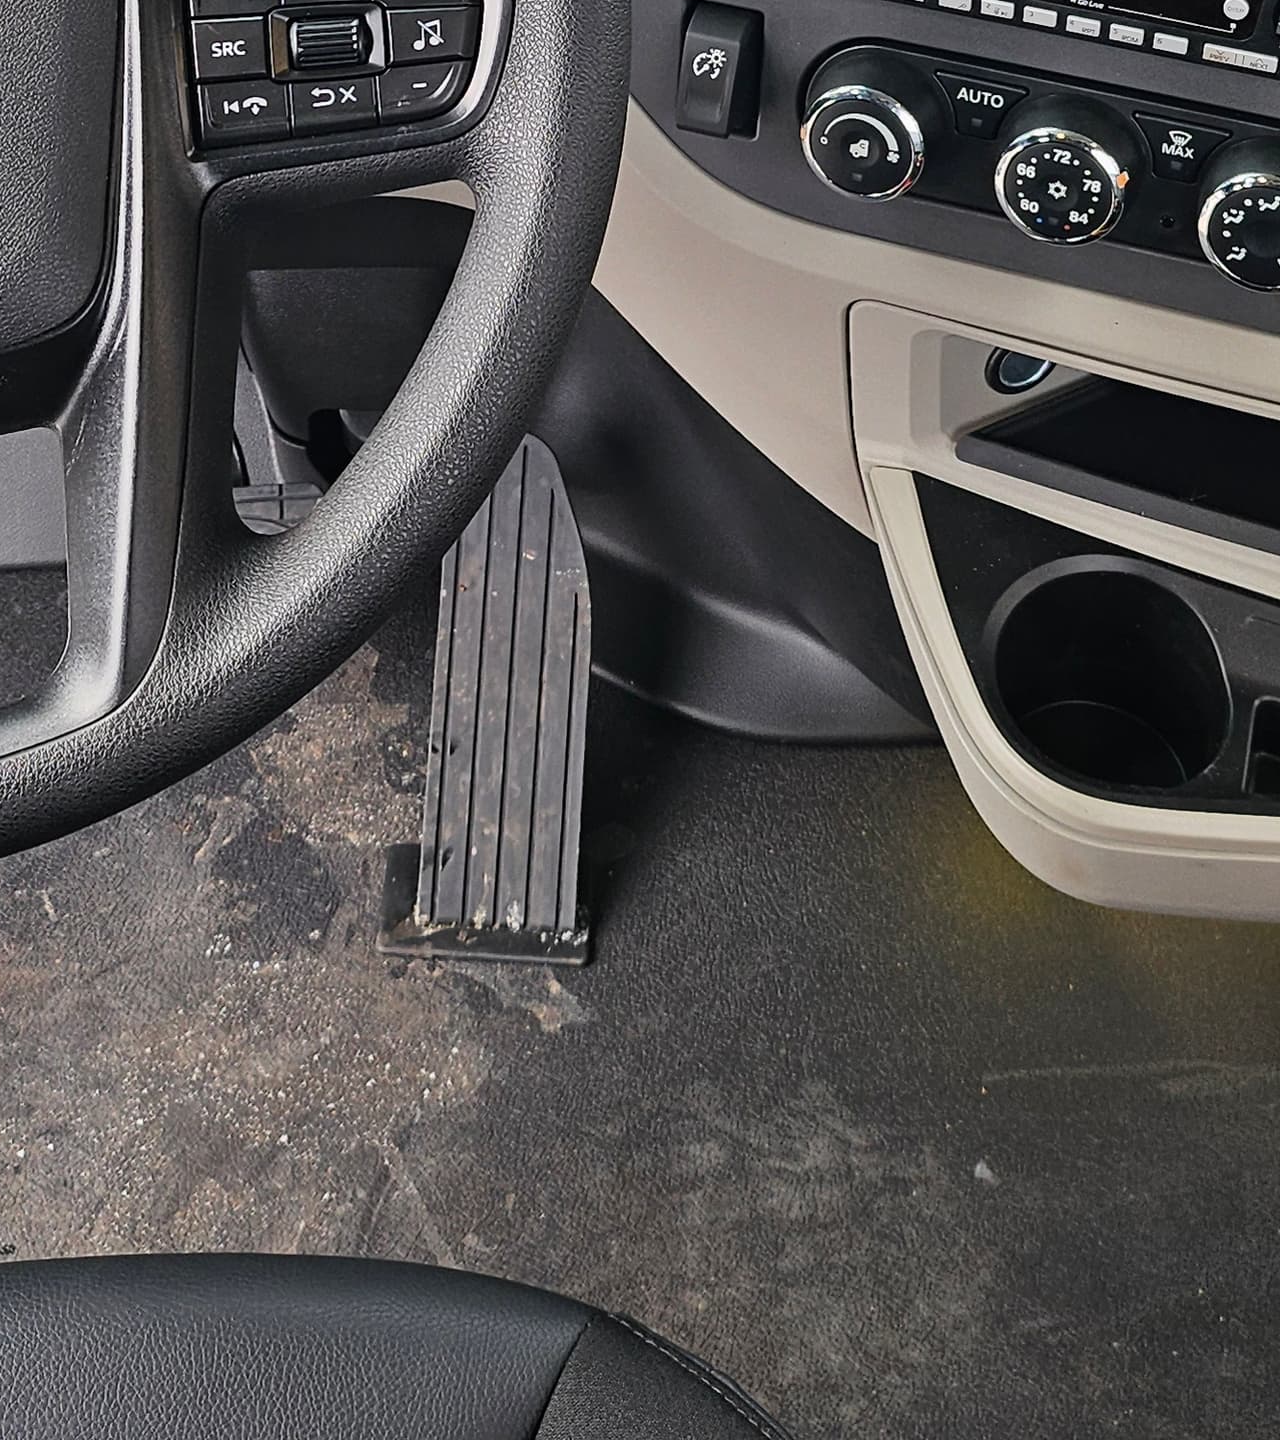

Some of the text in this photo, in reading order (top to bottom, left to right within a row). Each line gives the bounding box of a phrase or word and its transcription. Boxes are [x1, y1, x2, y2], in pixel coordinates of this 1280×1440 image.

[211, 40, 246, 58] SRC
[956, 87, 1005, 109] AUTO
[1052, 149, 1072, 164] 72
[1161, 143, 1194, 160] MAX
[1016, 164, 1037, 179] 66
[1081, 179, 1102, 194] 78
[1020, 198, 1040, 213] 60
[1068, 210, 1089, 225] 84
